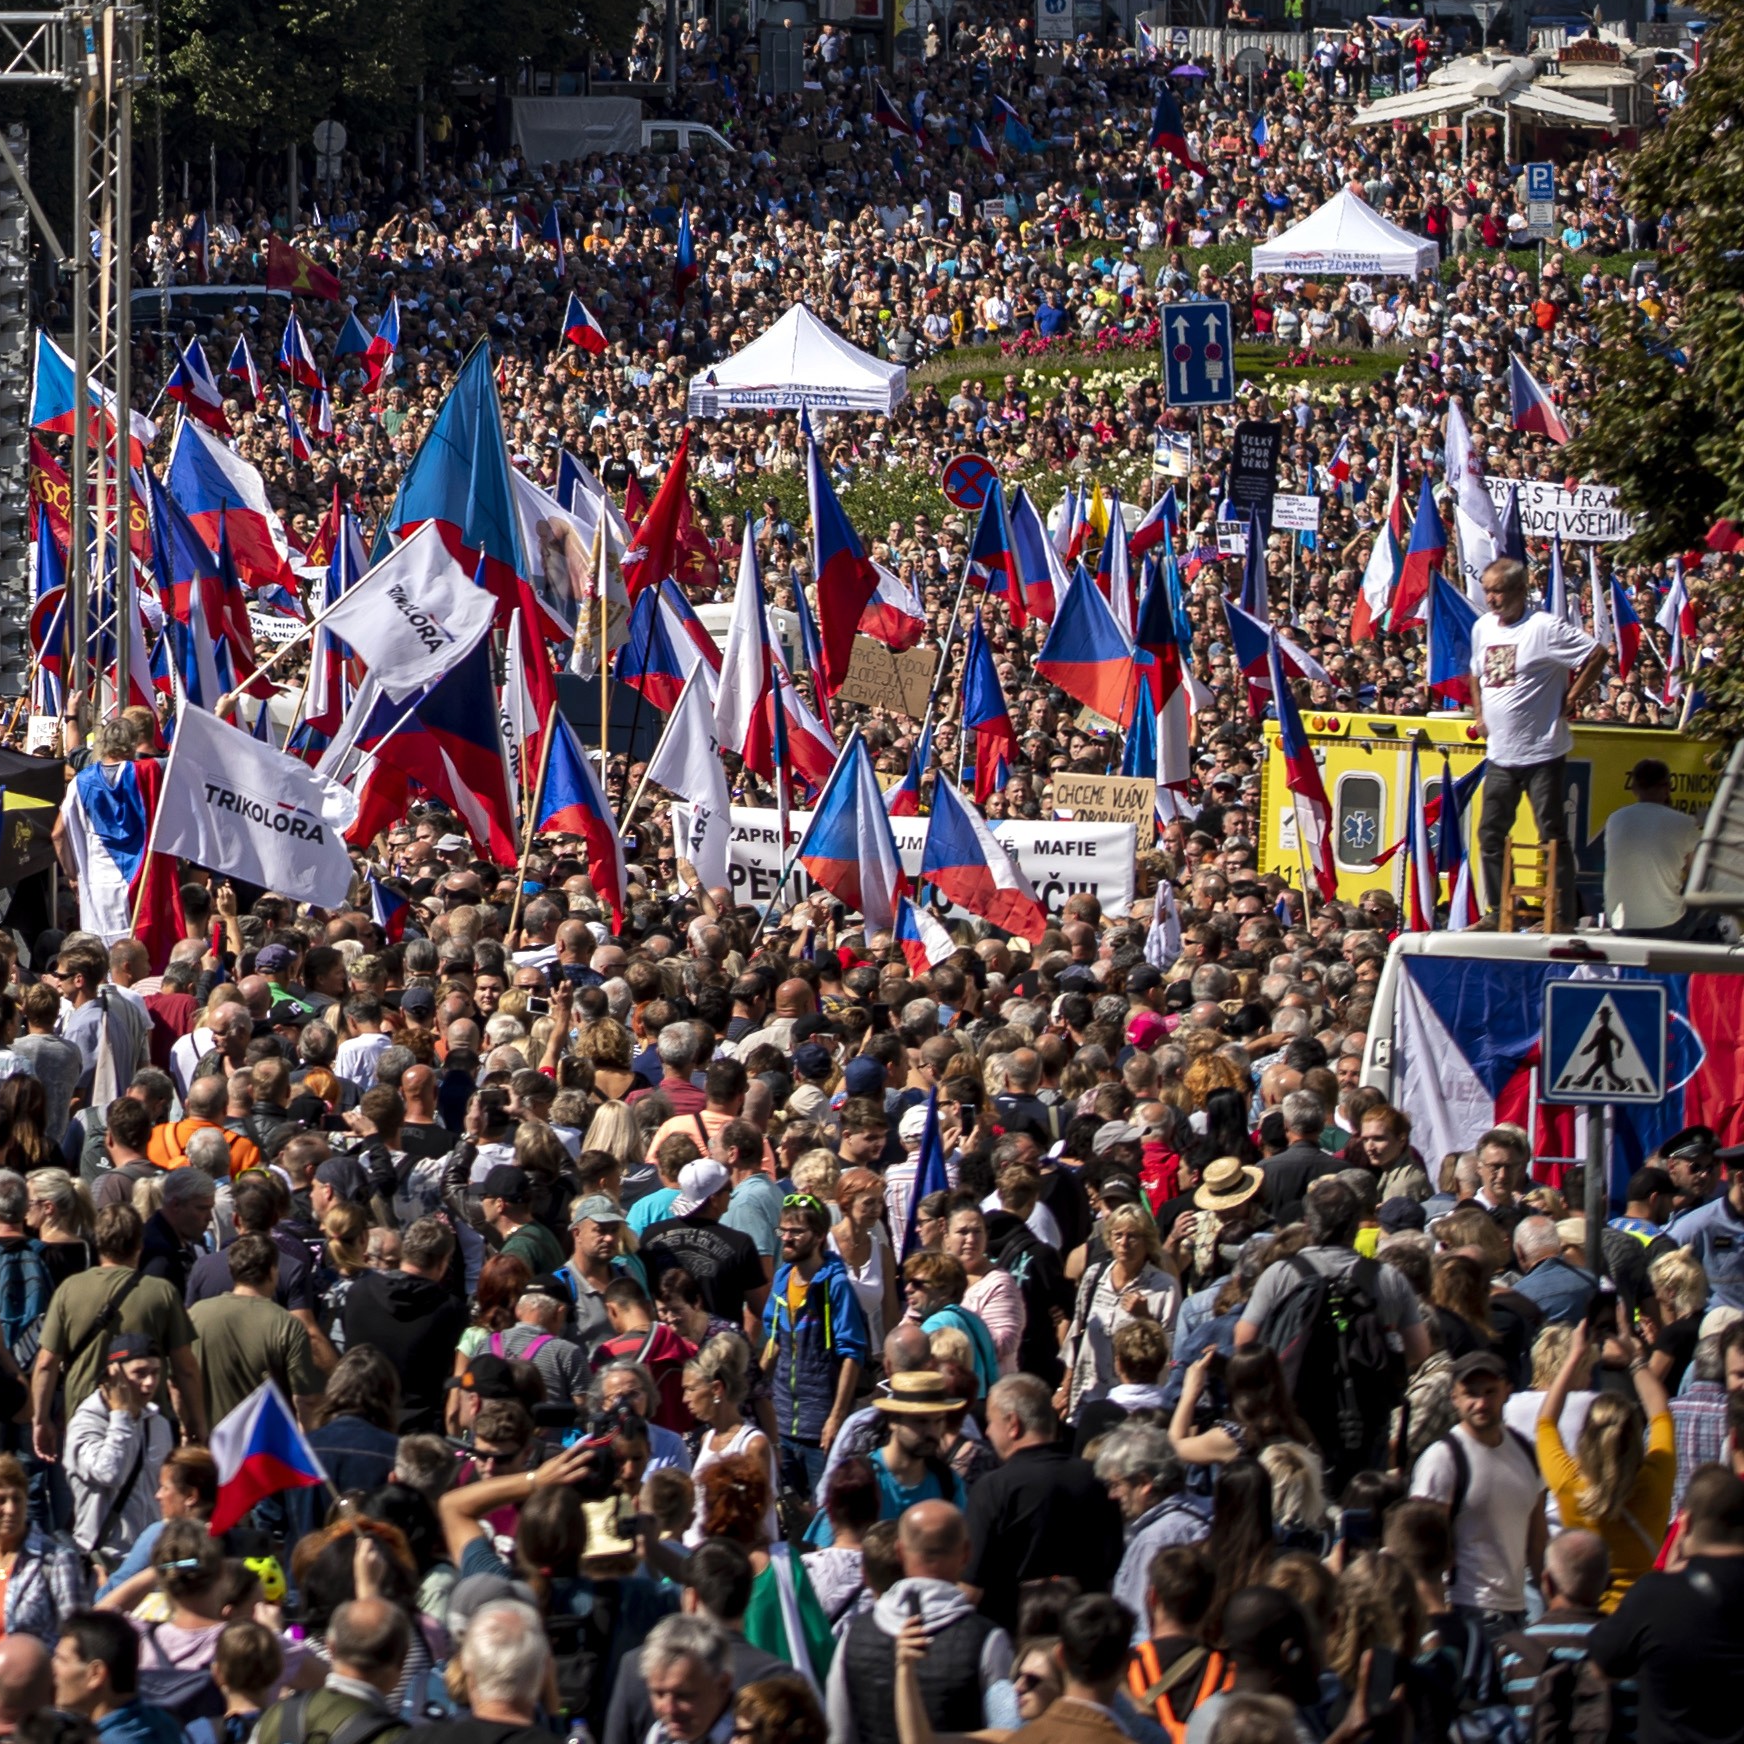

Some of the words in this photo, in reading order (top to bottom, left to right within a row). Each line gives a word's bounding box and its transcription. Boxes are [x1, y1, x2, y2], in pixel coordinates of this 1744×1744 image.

[1533, 167, 1548, 190] P
[1328, 260, 1383, 272] ZDARMA
[729, 392, 778, 405] KNIHY
[782, 393, 850, 406] ZDARMA
[1241, 434, 1273, 447] VELKÝ
[1057, 783, 1105, 805] CHCEME
[205, 782, 324, 847] TRIKOLORA
[1034, 839, 1097, 857] MAFIE
